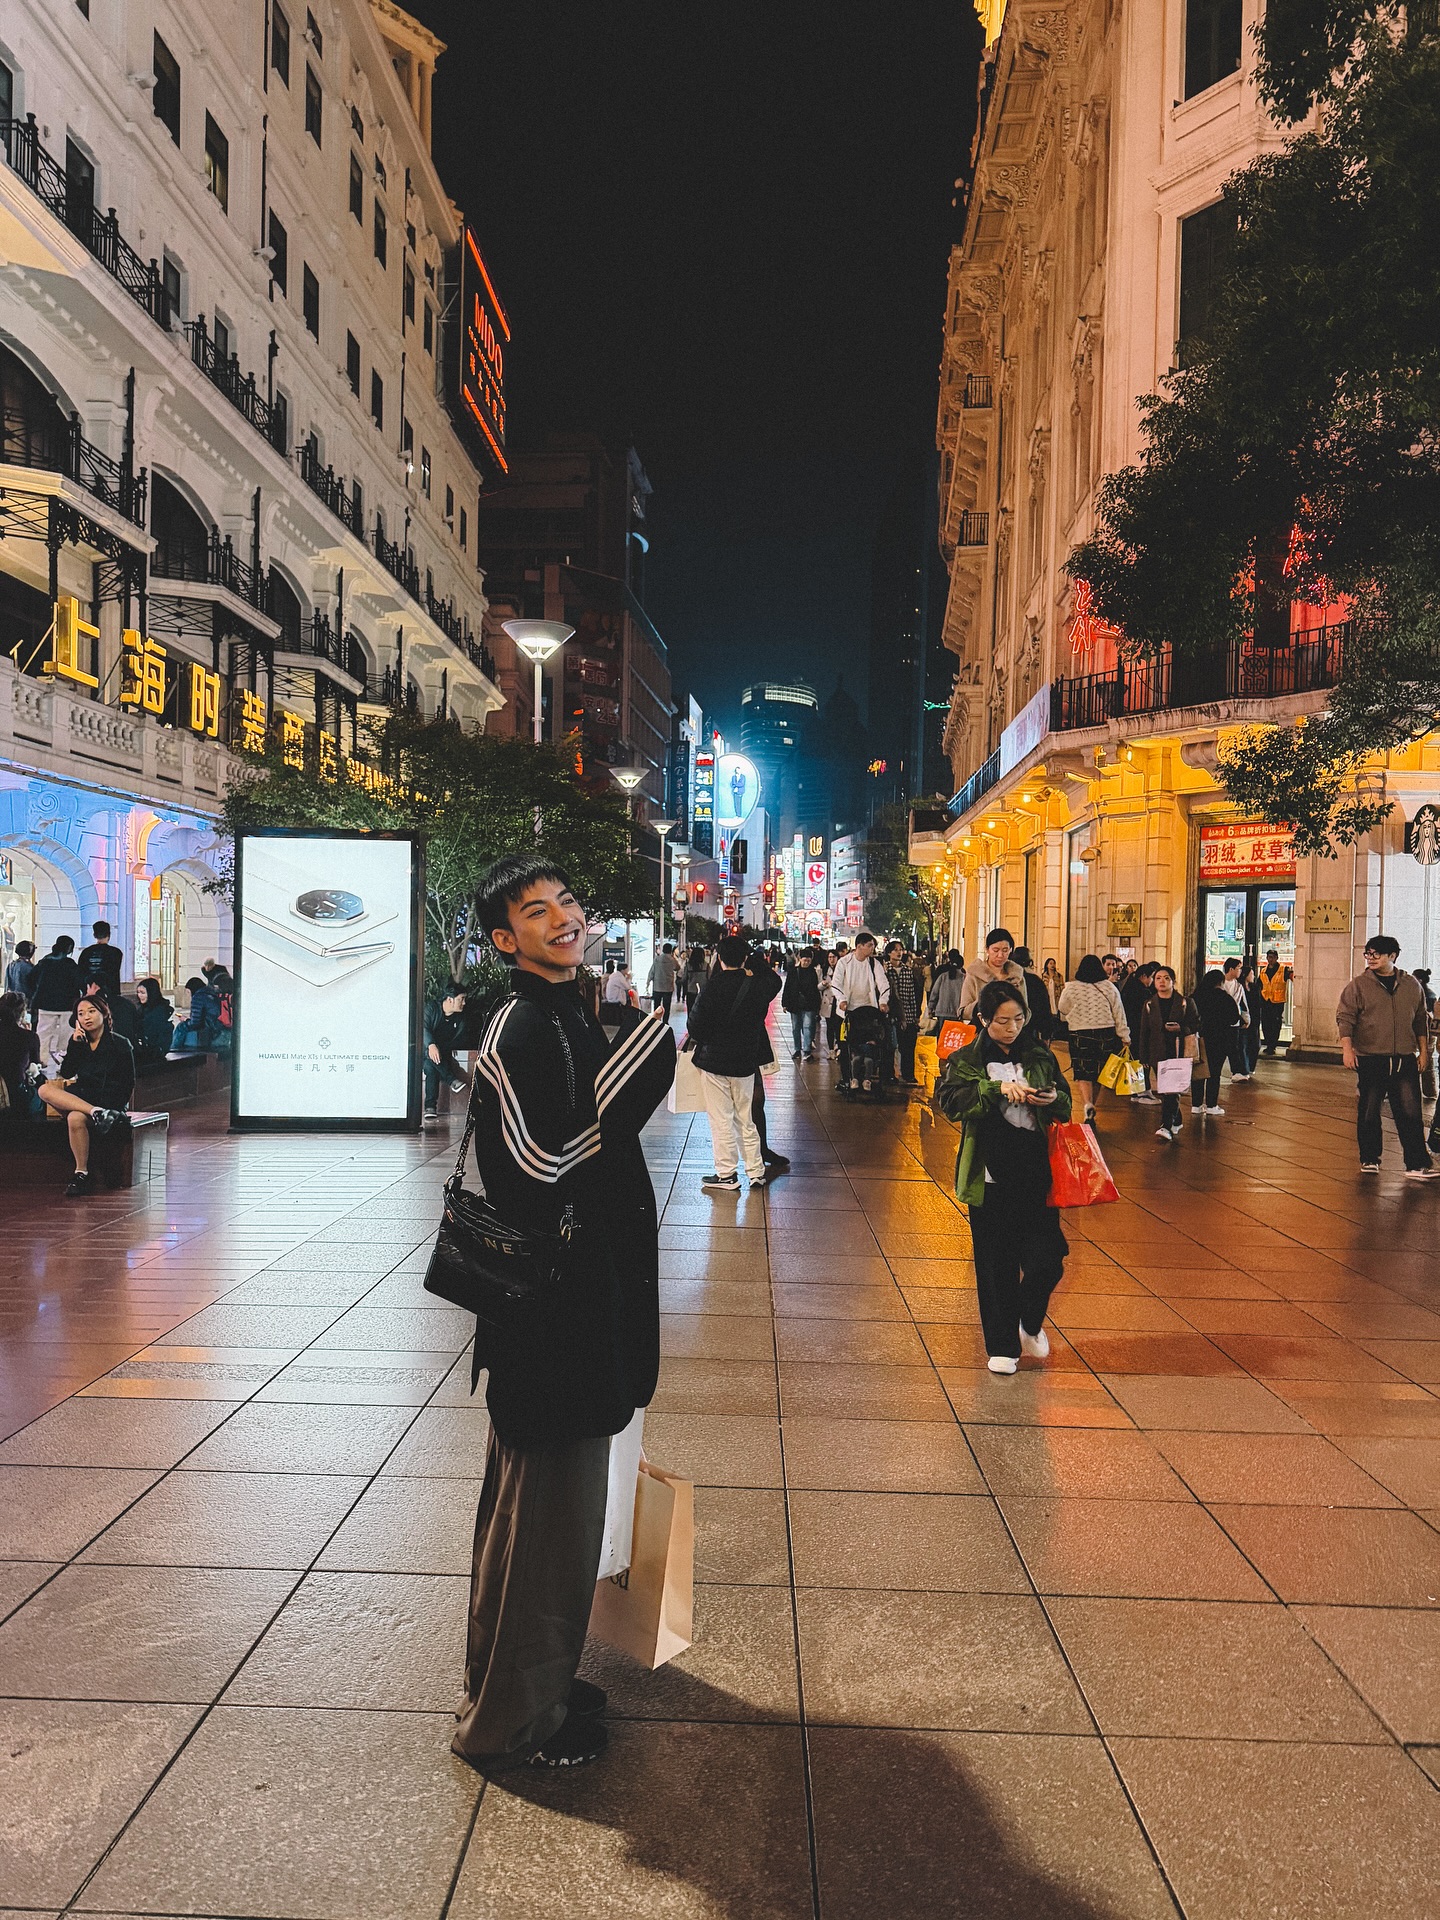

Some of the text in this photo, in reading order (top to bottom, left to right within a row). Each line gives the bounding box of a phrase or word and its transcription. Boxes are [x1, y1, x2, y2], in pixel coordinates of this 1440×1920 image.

[475, 293, 502, 379] MIDO
[294, 1063, 355, 1072] 非凡大师
